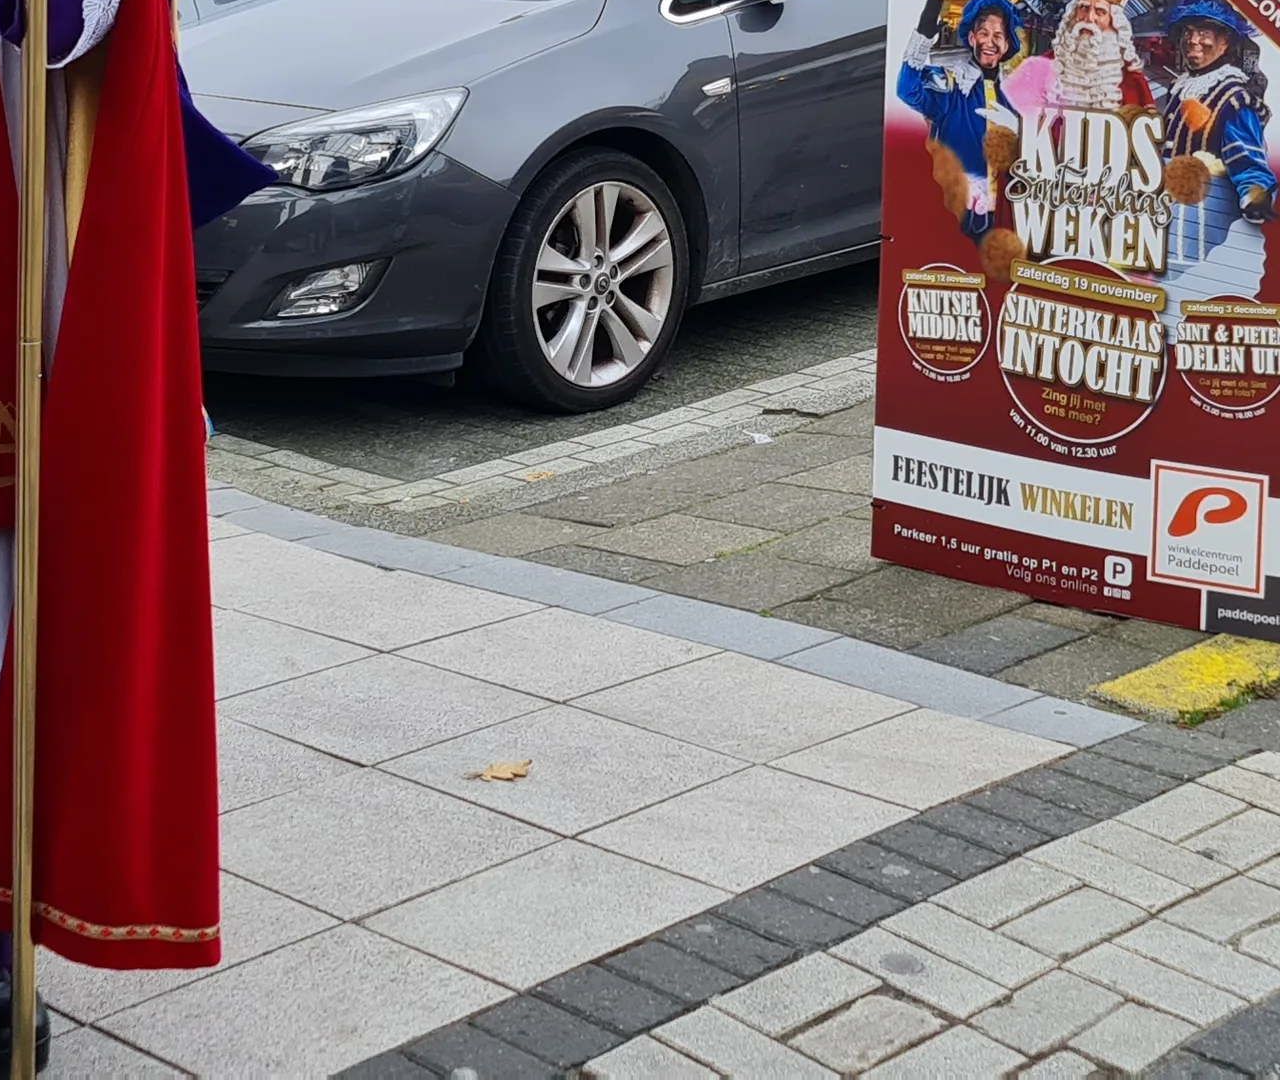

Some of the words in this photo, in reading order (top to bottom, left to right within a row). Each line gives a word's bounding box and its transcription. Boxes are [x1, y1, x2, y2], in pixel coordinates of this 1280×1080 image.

[1020, 107, 1163, 193] KIDS
[1005, 157, 1176, 227] Sinterklaas
[1013, 200, 1164, 270] WEKEN
[905, 272, 935, 283] zaterdag
[936, 275, 945, 283] 12
[946, 275, 982, 285] november
[1017, 266, 1070, 289] zaterdag
[1073, 276, 1088, 290] 19
[1091, 282, 1159, 304] november
[907, 288, 981, 317] KNUTSEL
[1187, 304, 1224, 314] zaterdag
[1226, 305, 1232, 313] 3
[1233, 306, 1277, 315] december
[907, 312, 982, 343] MIDDAG
[1005, 293, 1163, 353] SINTERKLAAS
[1177, 322, 1211, 342] SINT
[1214, 324, 1229, 343] &
[1001, 325, 1160, 401] INTOCHT
[1175, 343, 1245, 374] DELEN
[1042, 388, 1067, 405] Zing
[1069, 395, 1081, 409] jij
[1083, 398, 1106, 412] met
[1044, 404, 1066, 418] ons
[1068, 411, 1101, 425] mee?
[1009, 409, 1025, 428] van
[1025, 424, 1049, 447] 11.00
[1050, 441, 1068, 455] van
[1070, 446, 1097, 458] 12.30
[1099, 444, 1117, 458] uur
[892, 454, 1011, 507] FEESTELIJK
[1020, 481, 1133, 531] WINKELEN
[893, 523, 937, 544] Parkeer
[940, 535, 957, 550] 1,5
[961, 542, 980, 556] uur
[984, 547, 1019, 564] gratis
[1022, 556, 1038, 570] op
[1042, 559, 1057, 572] P1
[1061, 564, 1077, 576] en
[1081, 568, 1098, 581] P2
[1167, 543, 1243, 563] winkelcentrum
[1168, 554, 1240, 577] Paddepoel
[1005, 564, 1032, 582] Volg
[1035, 574, 1057, 586] ons
[1061, 577, 1098, 594] online
